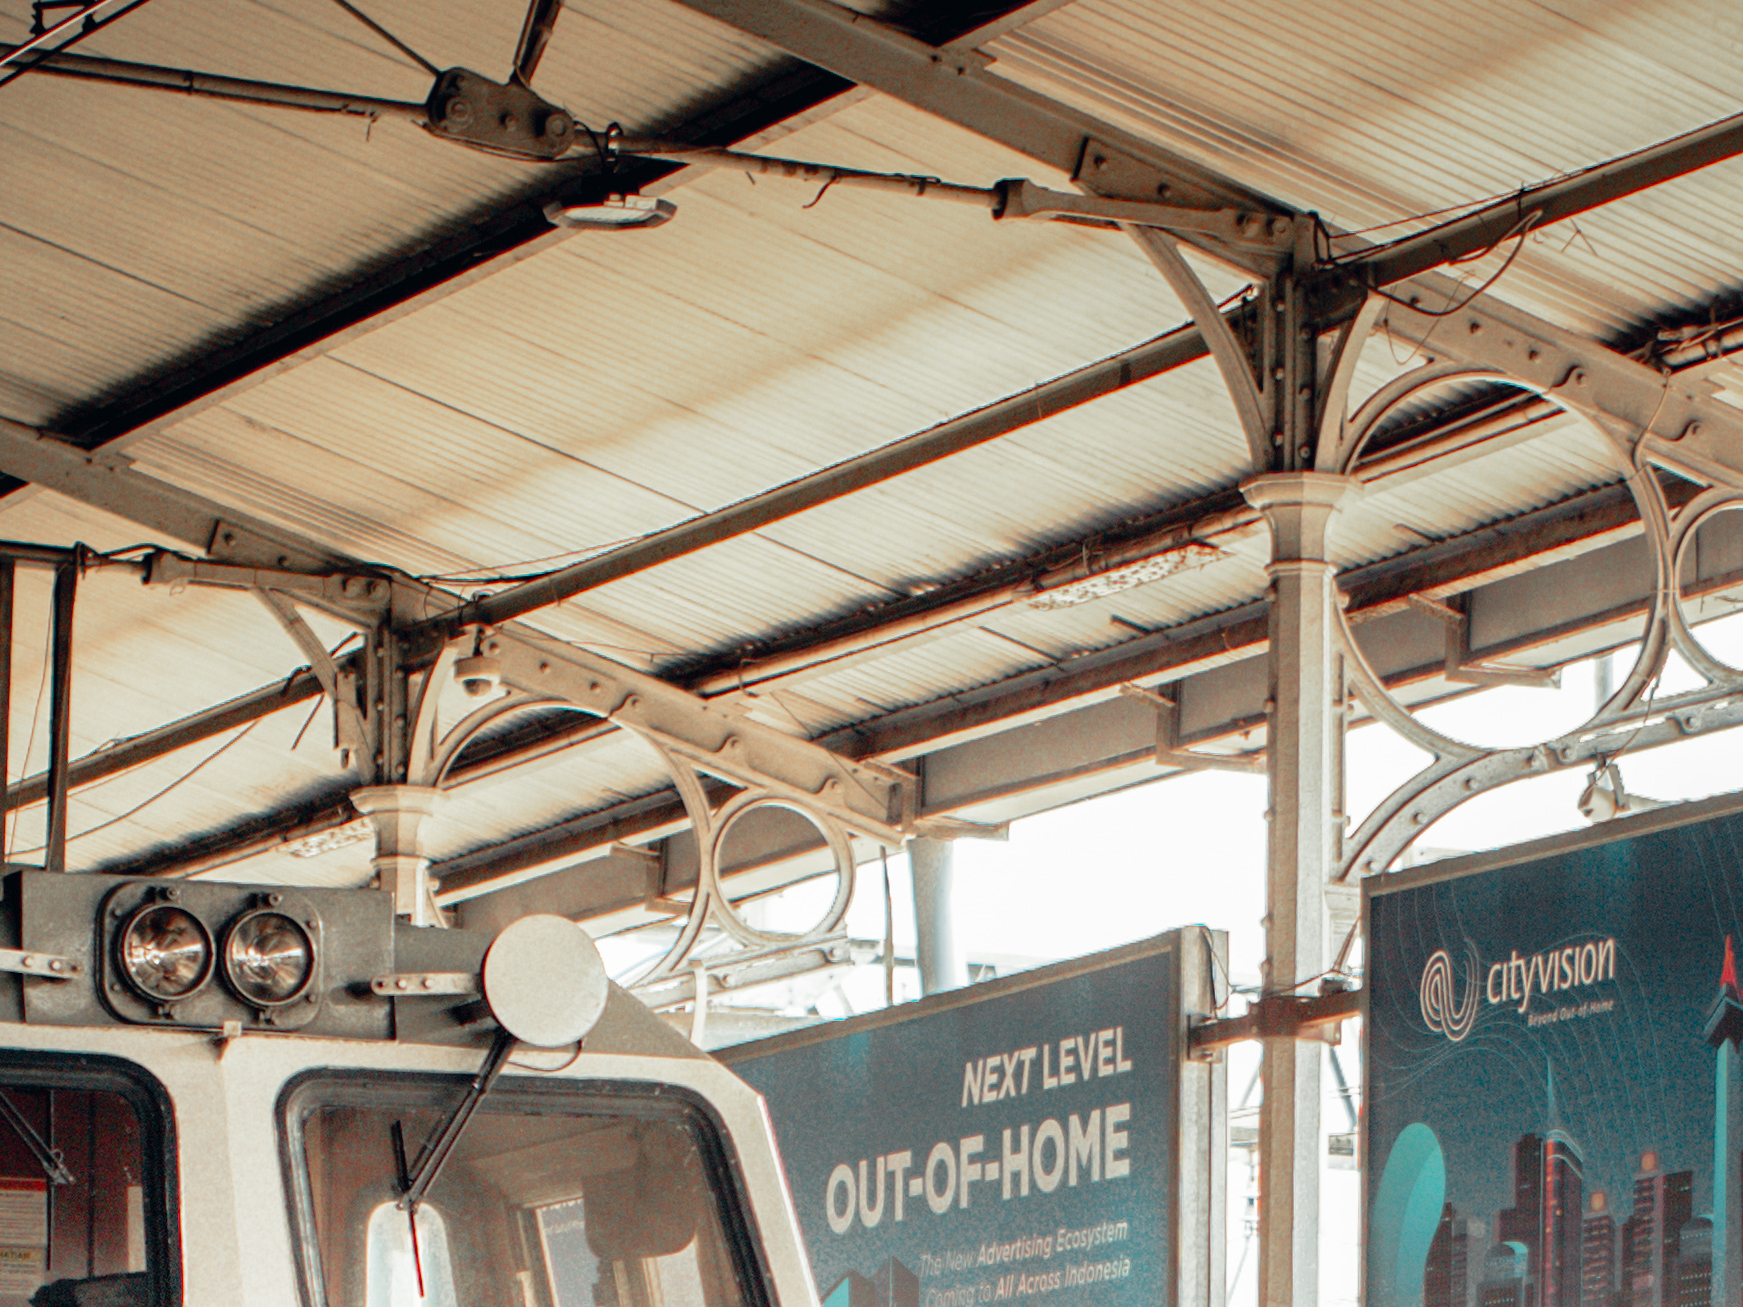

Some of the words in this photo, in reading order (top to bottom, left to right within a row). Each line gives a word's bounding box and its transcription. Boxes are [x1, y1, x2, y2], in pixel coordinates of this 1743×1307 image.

[1486, 937, 1616, 1014] cityvision
[1527, 1007, 1558, 1028] Beyond
[960, 1045, 1038, 1108] NEXT
[1042, 1025, 1132, 1088] LEVEL
[825, 1103, 1132, 1236] OUT-OF-HOME
[920, 1253, 942, 1277] The
[945, 1248, 974, 1273] New
[976, 1234, 1053, 1268] Advertising
[1055, 1220, 1128, 1253] Ecosystem
[978, 1283, 992, 1304] to
[995, 1275, 1015, 1301] All
[1016, 1269, 1061, 1297] Across
[1064, 1254, 1131, 1287] Indonesia
